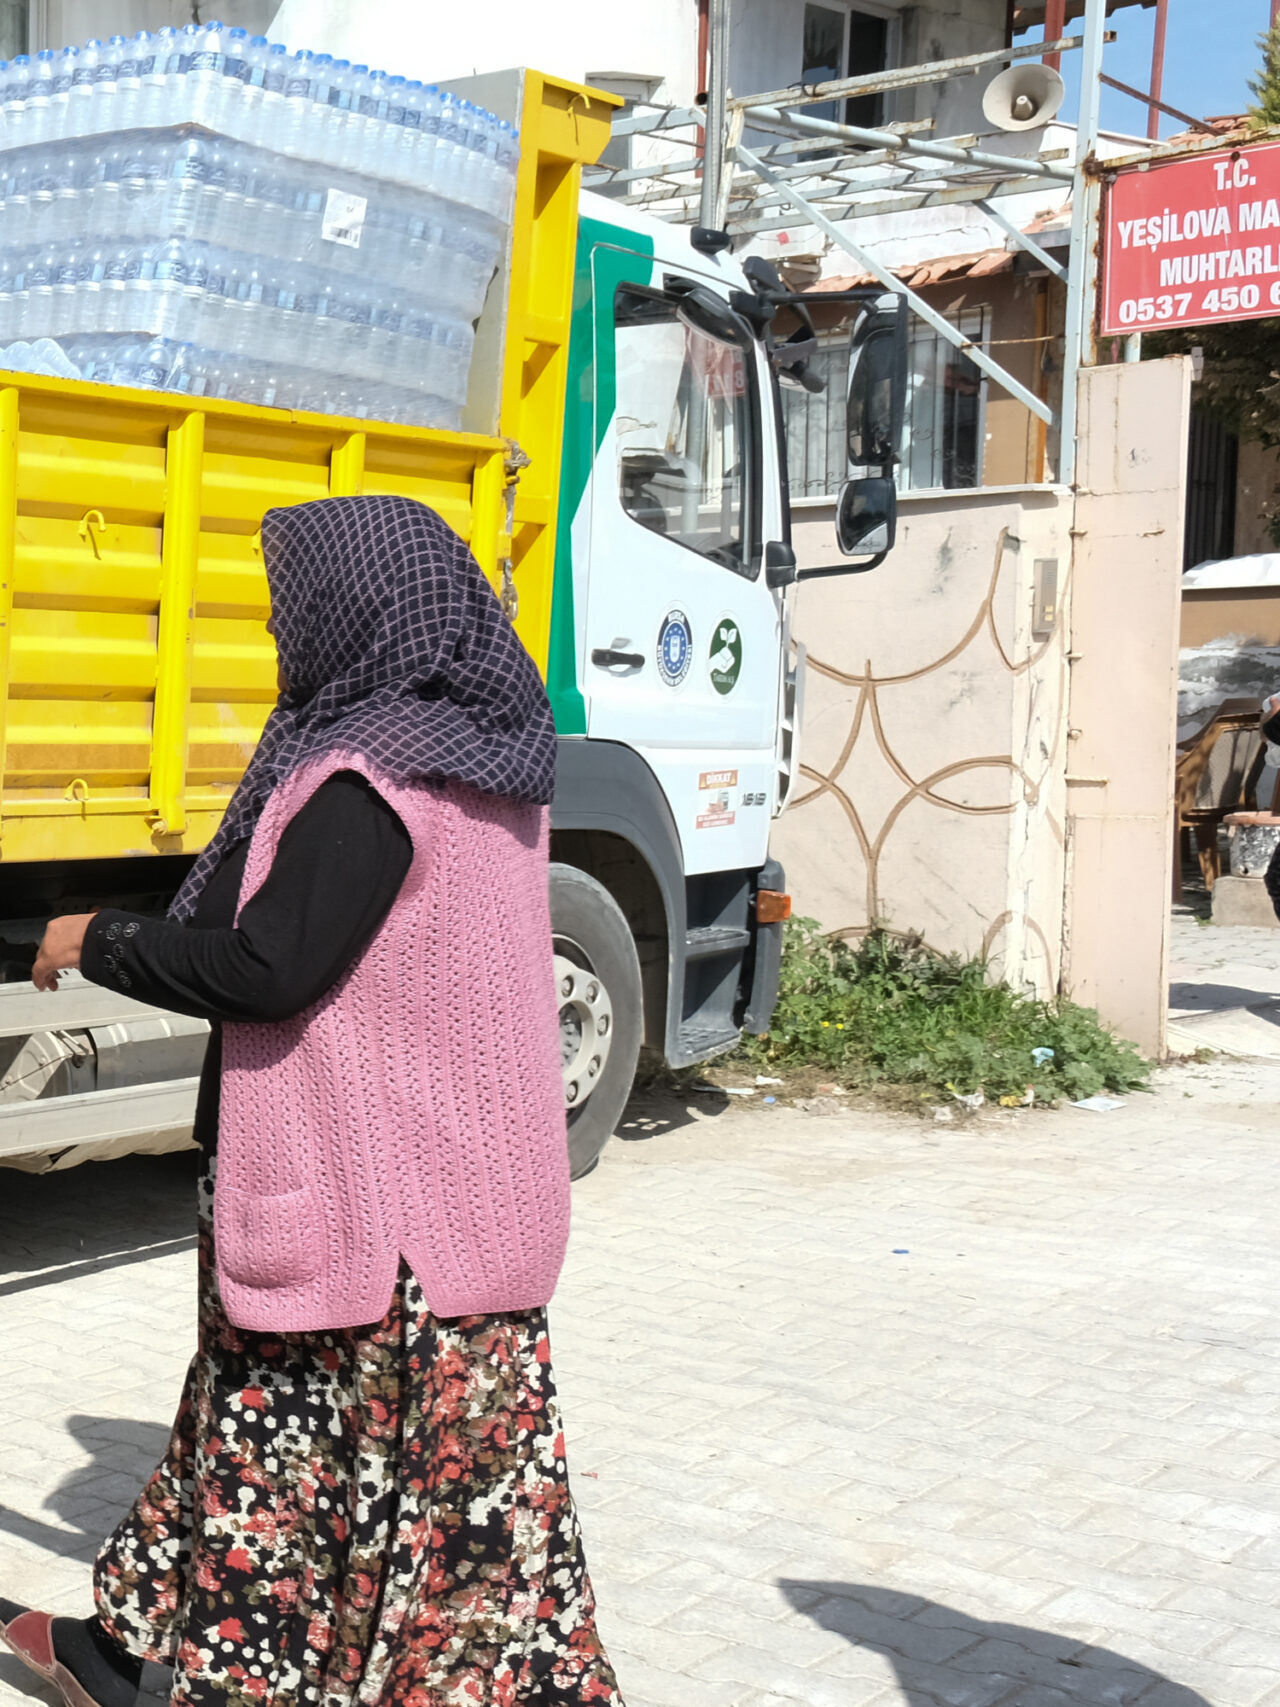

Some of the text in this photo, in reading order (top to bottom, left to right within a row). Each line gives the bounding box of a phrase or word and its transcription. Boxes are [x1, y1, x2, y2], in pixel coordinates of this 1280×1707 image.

[1213, 157, 1257, 191] T.C.
[1117, 206, 1232, 254] YEŞİLOVA
[1159, 243, 1280, 287] MUHTARL
[1119, 292, 1193, 324] 0537
[1201, 283, 1260, 313] 450
